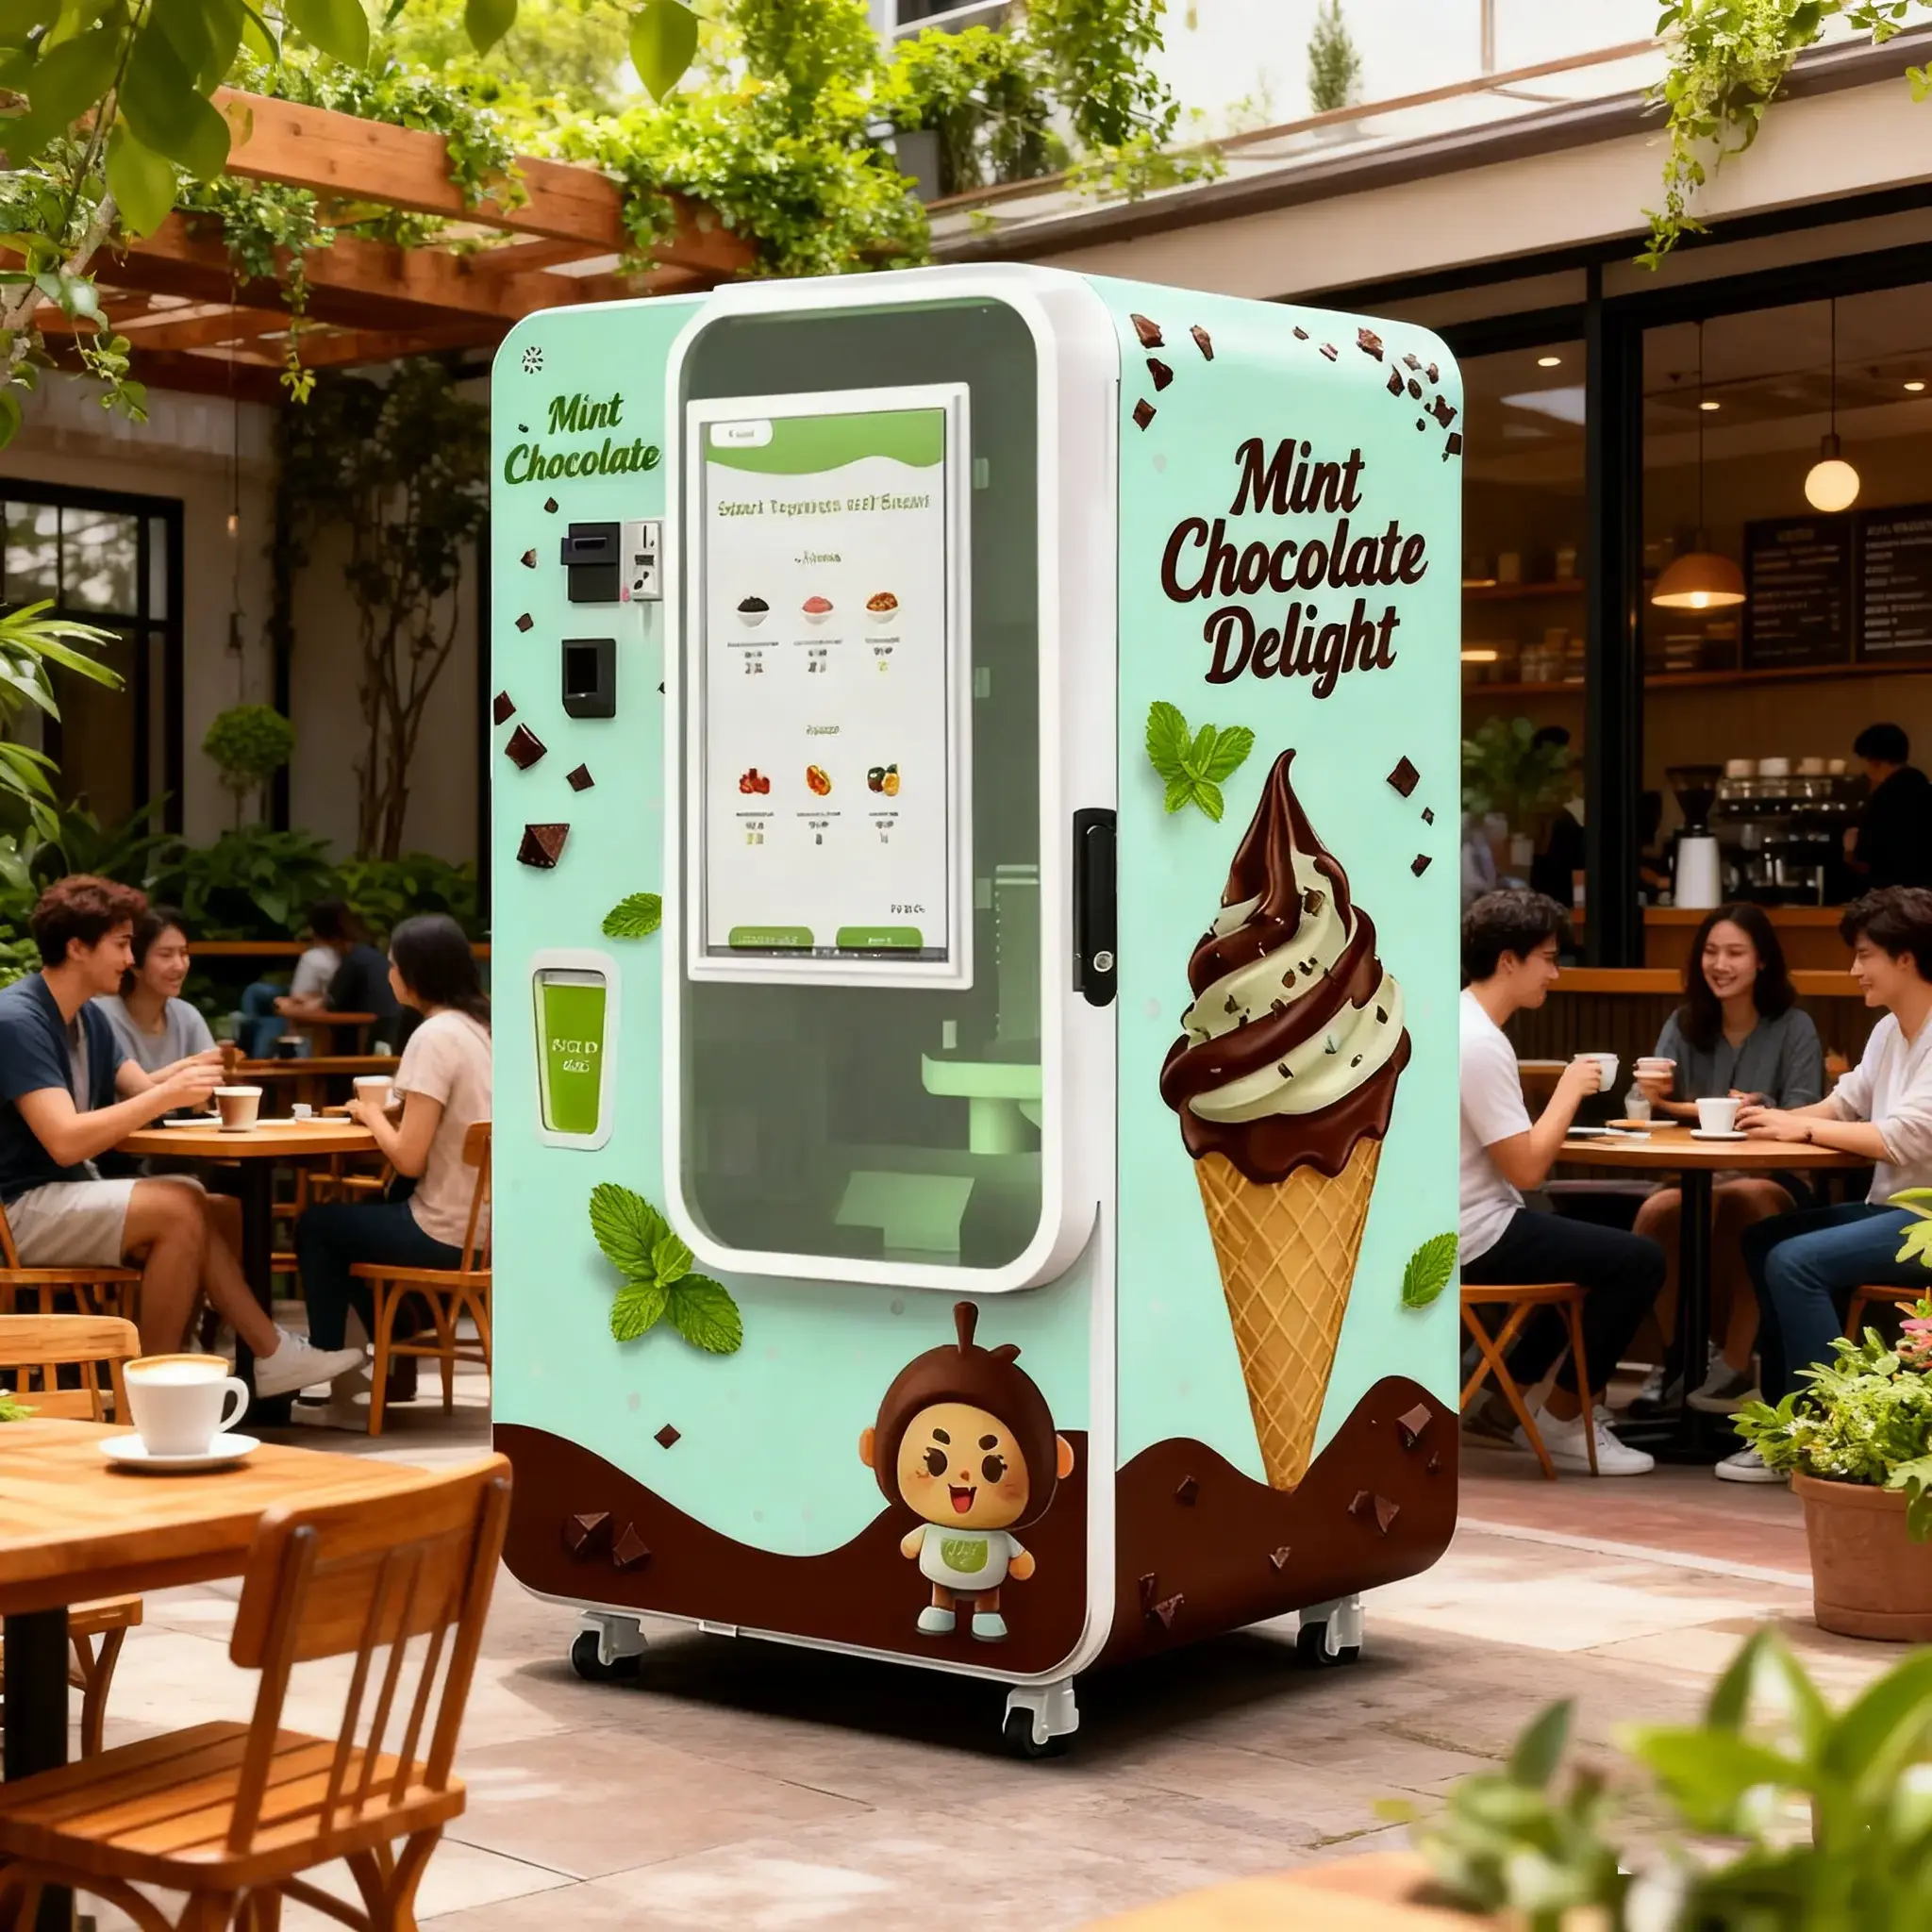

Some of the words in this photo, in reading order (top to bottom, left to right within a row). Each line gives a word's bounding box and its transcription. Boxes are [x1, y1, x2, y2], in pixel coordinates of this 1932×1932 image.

[548, 392, 625, 435] Mint
[504, 437, 661, 485] Chocolate
[1229, 437, 1365, 516] Mint
[1160, 517, 1429, 604] Chocolate
[1204, 598, 1401, 700] Delight
